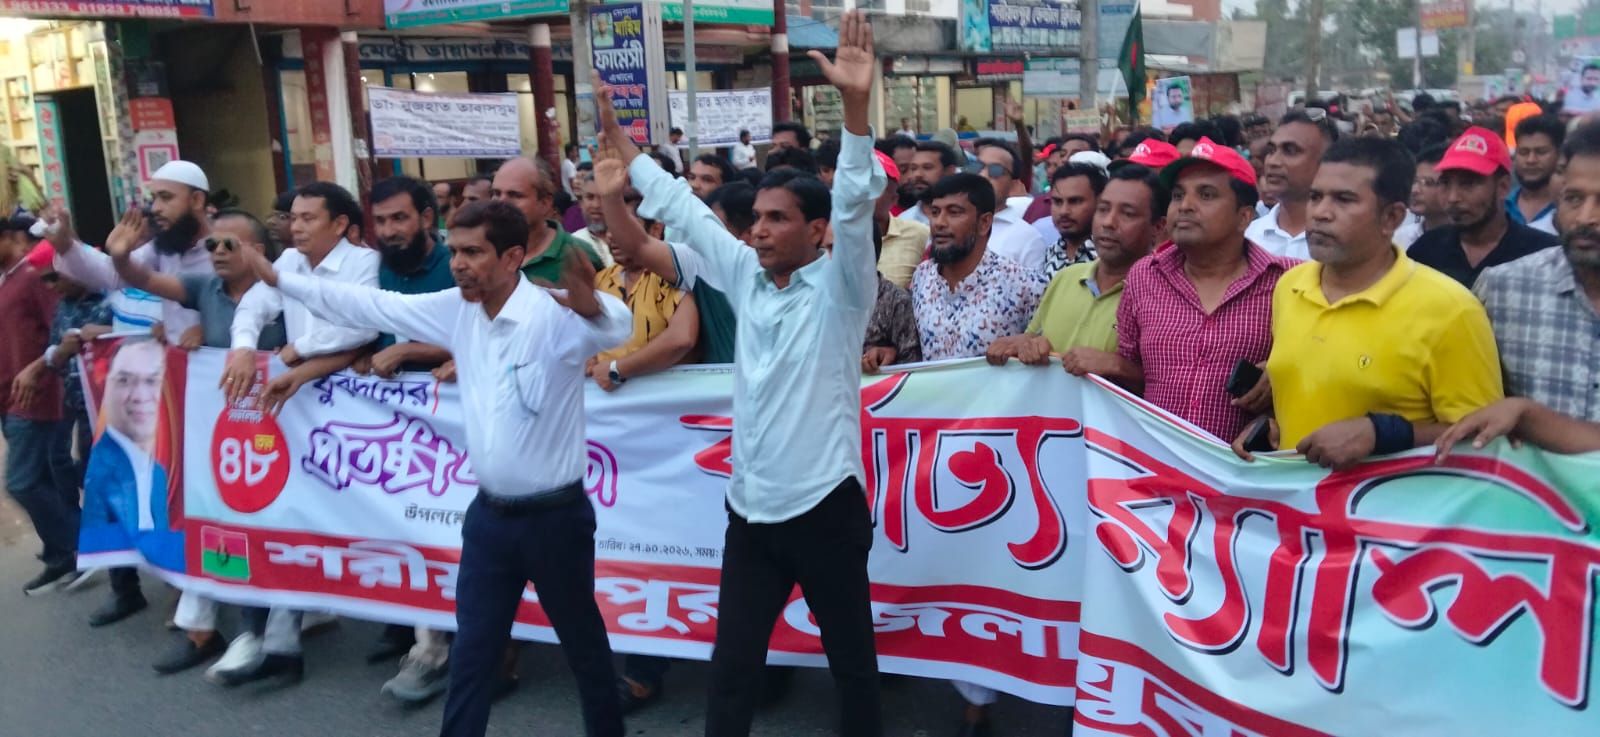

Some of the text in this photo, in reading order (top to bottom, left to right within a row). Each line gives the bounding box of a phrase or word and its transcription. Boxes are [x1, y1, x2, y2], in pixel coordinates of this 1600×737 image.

[593, 39, 644, 70] ফার্মেসী
[313, 374, 431, 407] যুবদলের
[219, 437, 280, 487] ৪৮
